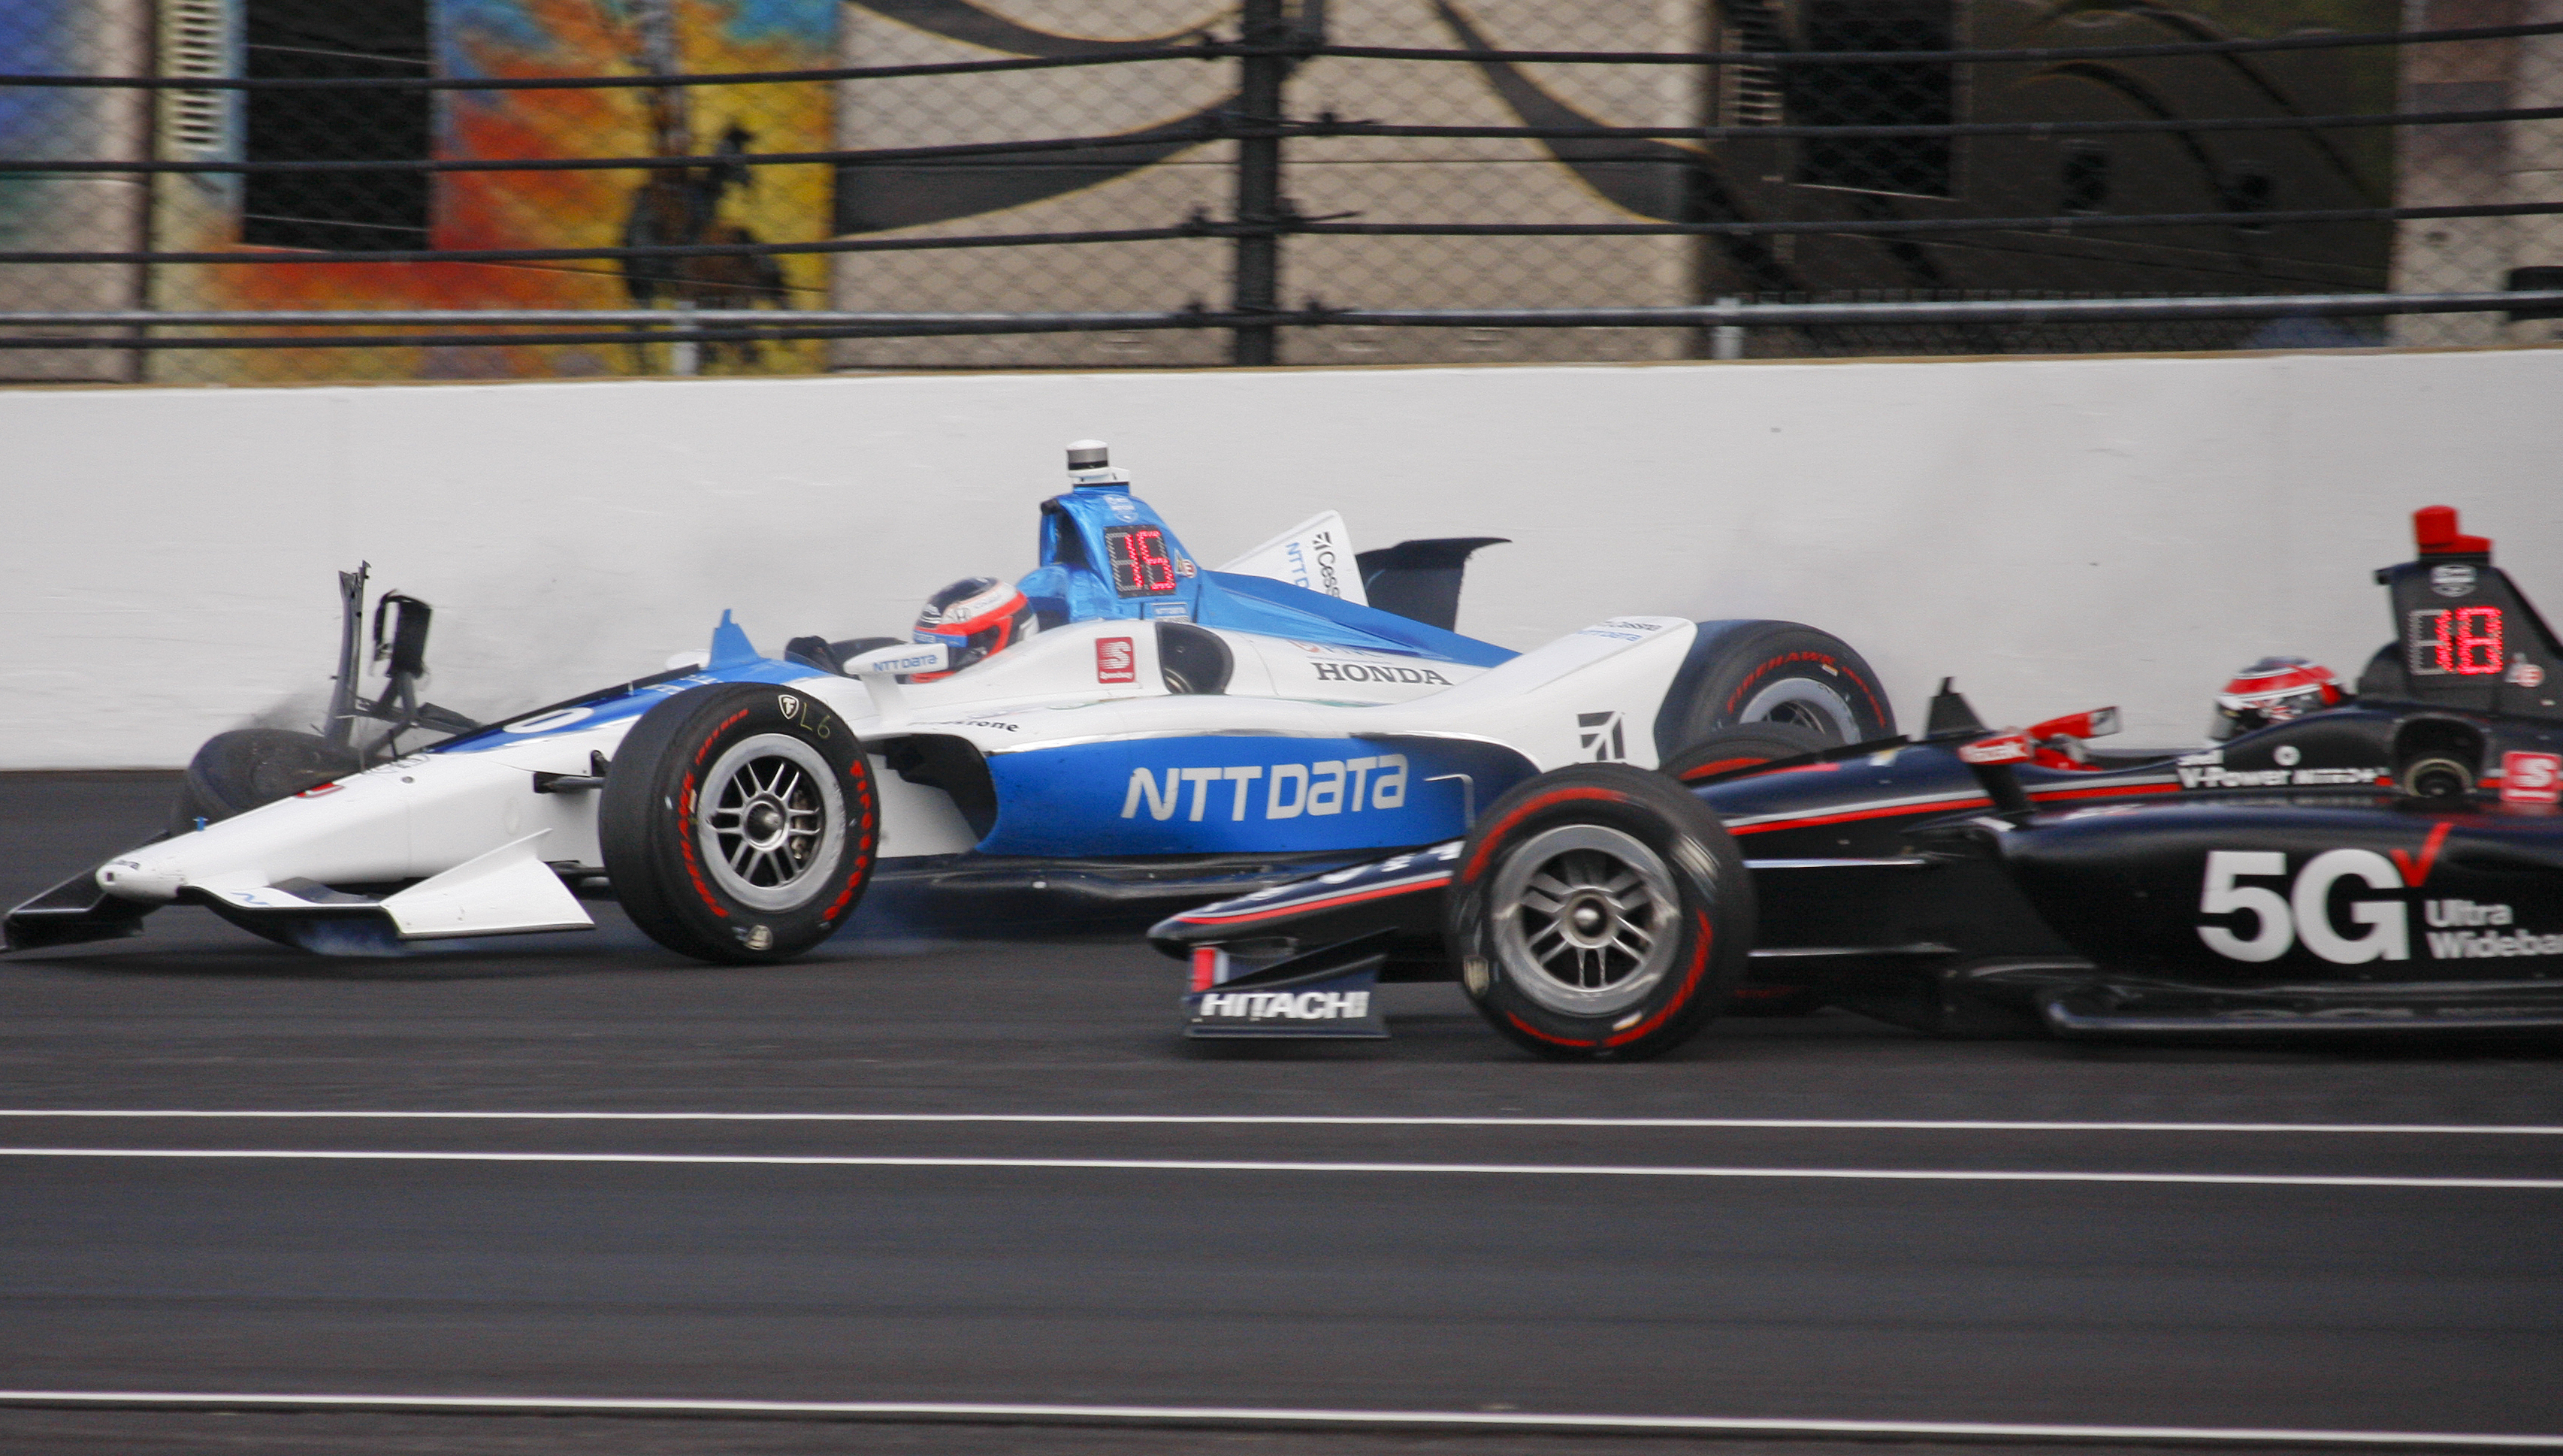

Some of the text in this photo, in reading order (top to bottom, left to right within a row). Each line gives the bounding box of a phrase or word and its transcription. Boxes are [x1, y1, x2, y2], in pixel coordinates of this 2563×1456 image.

[1124, 530, 1176, 591] 15
[2435, 606, 2504, 675] 18
[1310, 662, 1455, 687] HONDA
[1120, 766, 1263, 822] NTT
[2196, 848, 2410, 964] 5G
[1201, 991, 1370, 1020] HITACHI
